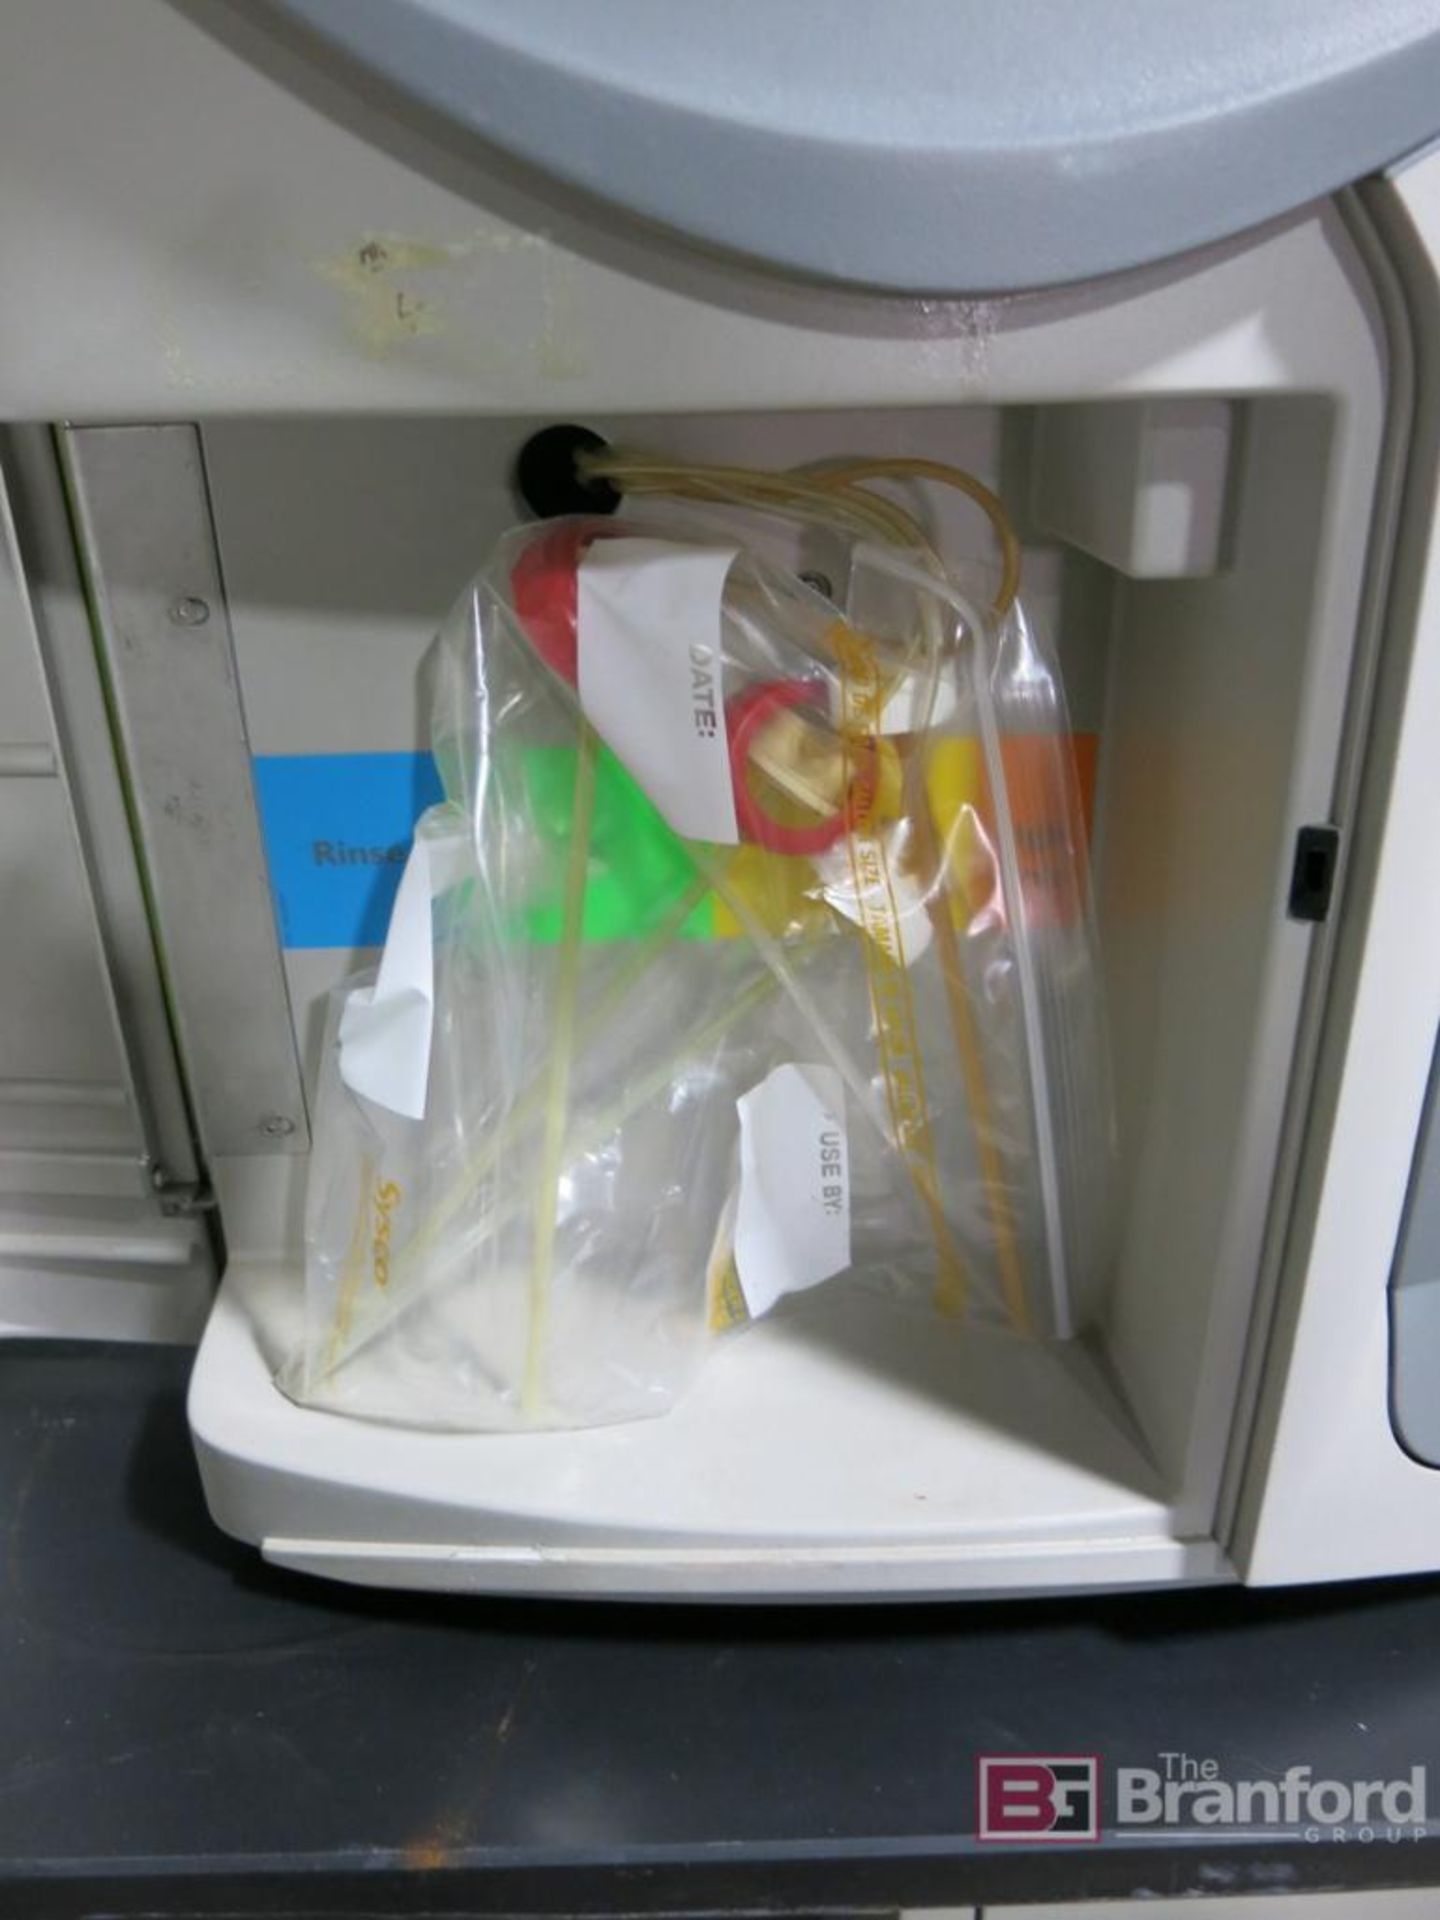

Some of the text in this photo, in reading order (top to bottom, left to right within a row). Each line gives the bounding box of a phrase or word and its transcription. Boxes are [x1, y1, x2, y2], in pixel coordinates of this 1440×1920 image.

[688, 643, 717, 738] DATE:
[819, 1131, 841, 1177] USE
[822, 1185, 843, 1215] BY:
